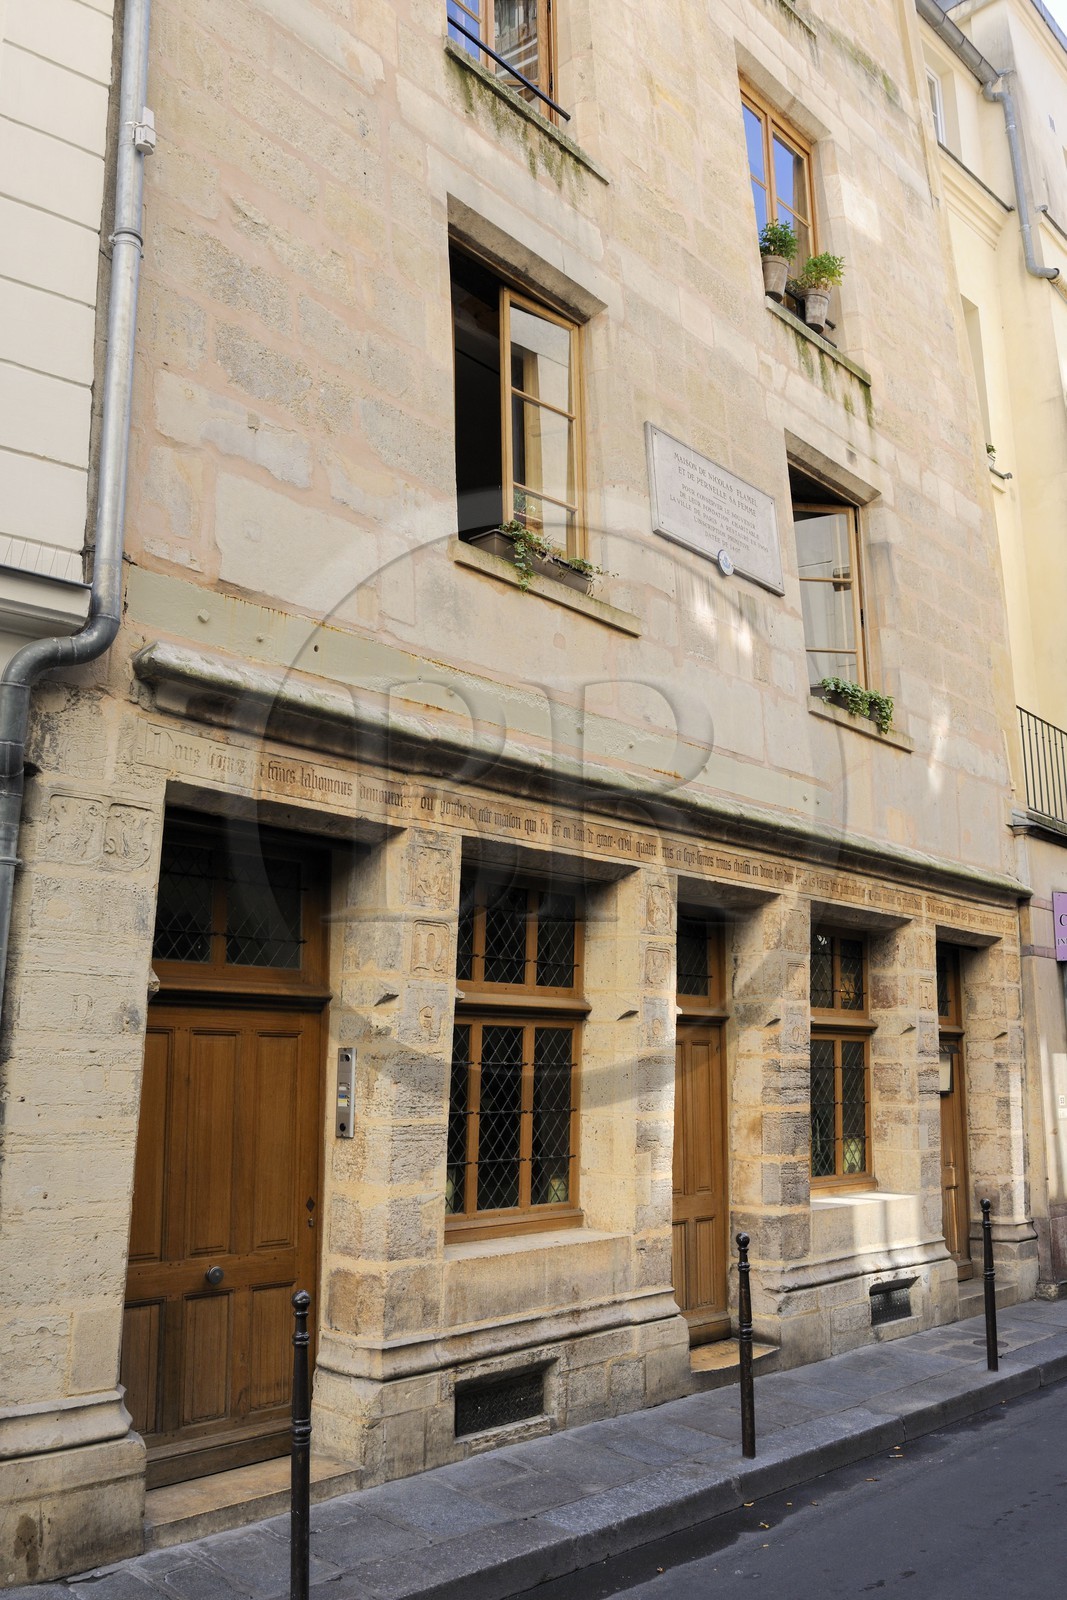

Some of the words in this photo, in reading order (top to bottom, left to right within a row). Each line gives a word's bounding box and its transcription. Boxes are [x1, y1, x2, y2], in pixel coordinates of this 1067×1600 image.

[673, 451, 697, 471] MAISON
[698, 466, 706, 477] DE
[707, 471, 733, 493] NICOLAS
[736, 488, 757, 507] FLAMEL
[678, 465, 685, 476] ET
[687, 471, 694, 482] DE
[696, 476, 726, 500] PERNELLE
[728, 495, 736, 505] SA
[737, 500, 756, 517] FEMME
[679, 490, 686, 499] DE
[688, 495, 700, 507] LEUR
[702, 503, 729, 523] FONDATION
[731, 519, 759, 539] CHARITABLE
[681, 483, 694, 495] POUR
[696, 492, 722, 511] CONSERVER
[724, 507, 730, 515] LE
[731, 511, 755, 529] SOUVENIR
